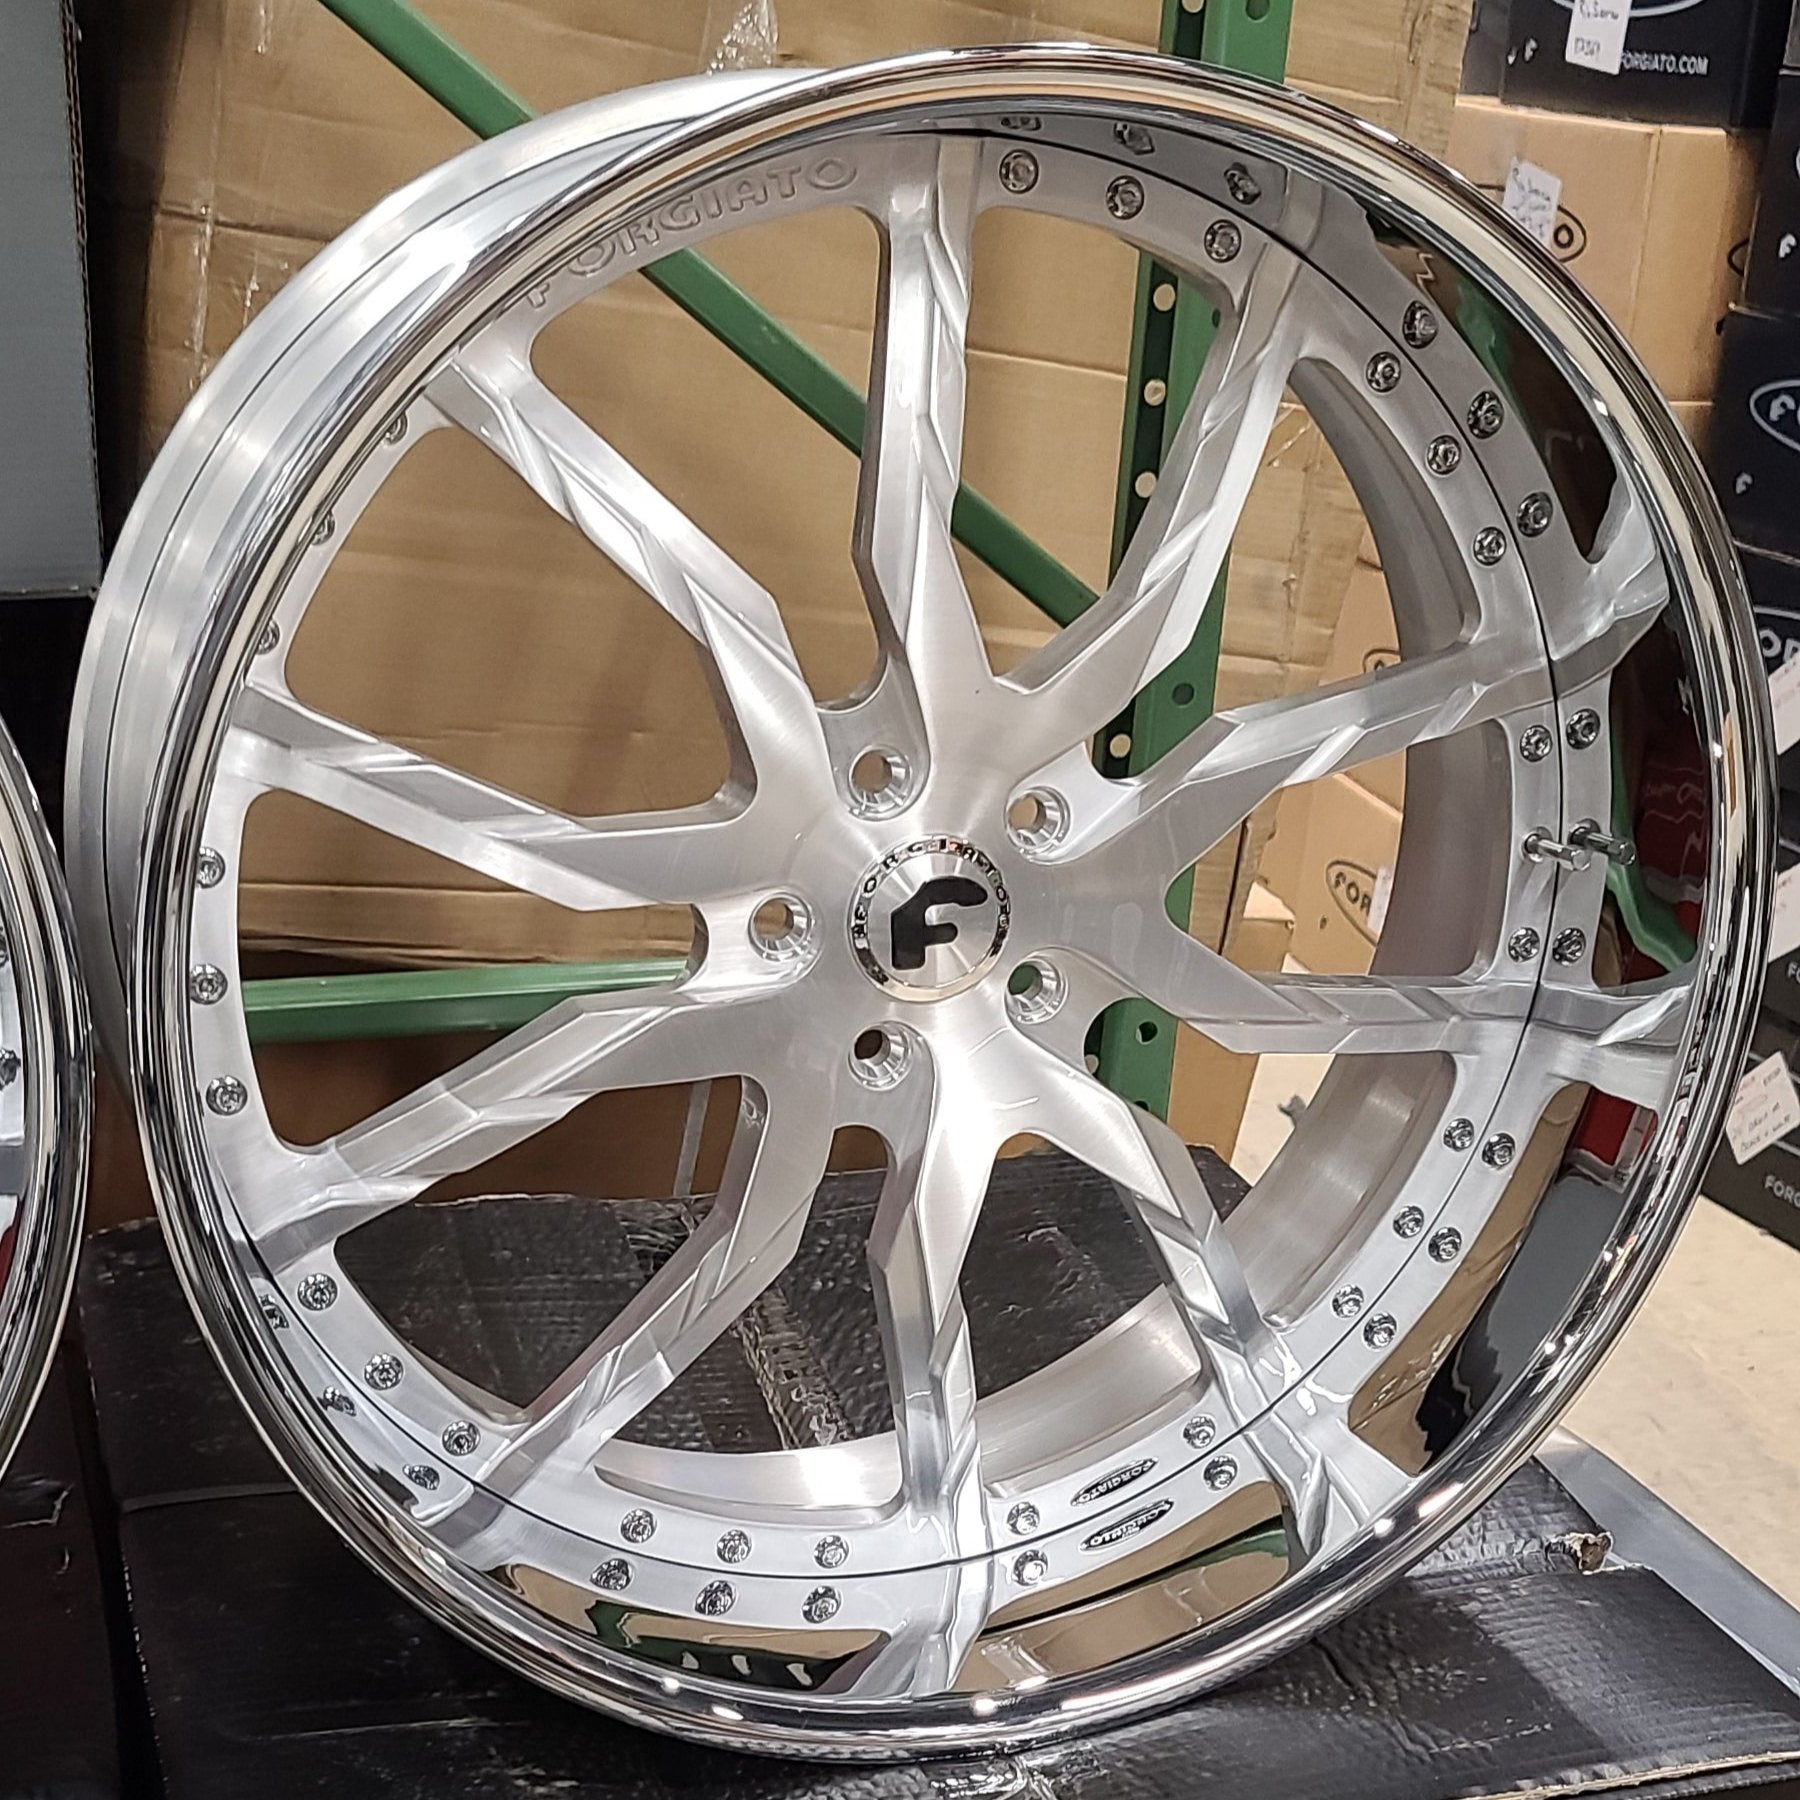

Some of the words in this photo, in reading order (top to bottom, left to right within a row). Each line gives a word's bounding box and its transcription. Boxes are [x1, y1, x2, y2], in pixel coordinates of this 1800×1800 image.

[1769, 395, 1800, 426] F
[890, 876, 988, 970] F
[1077, 1459, 1156, 1503] FORGIATO
